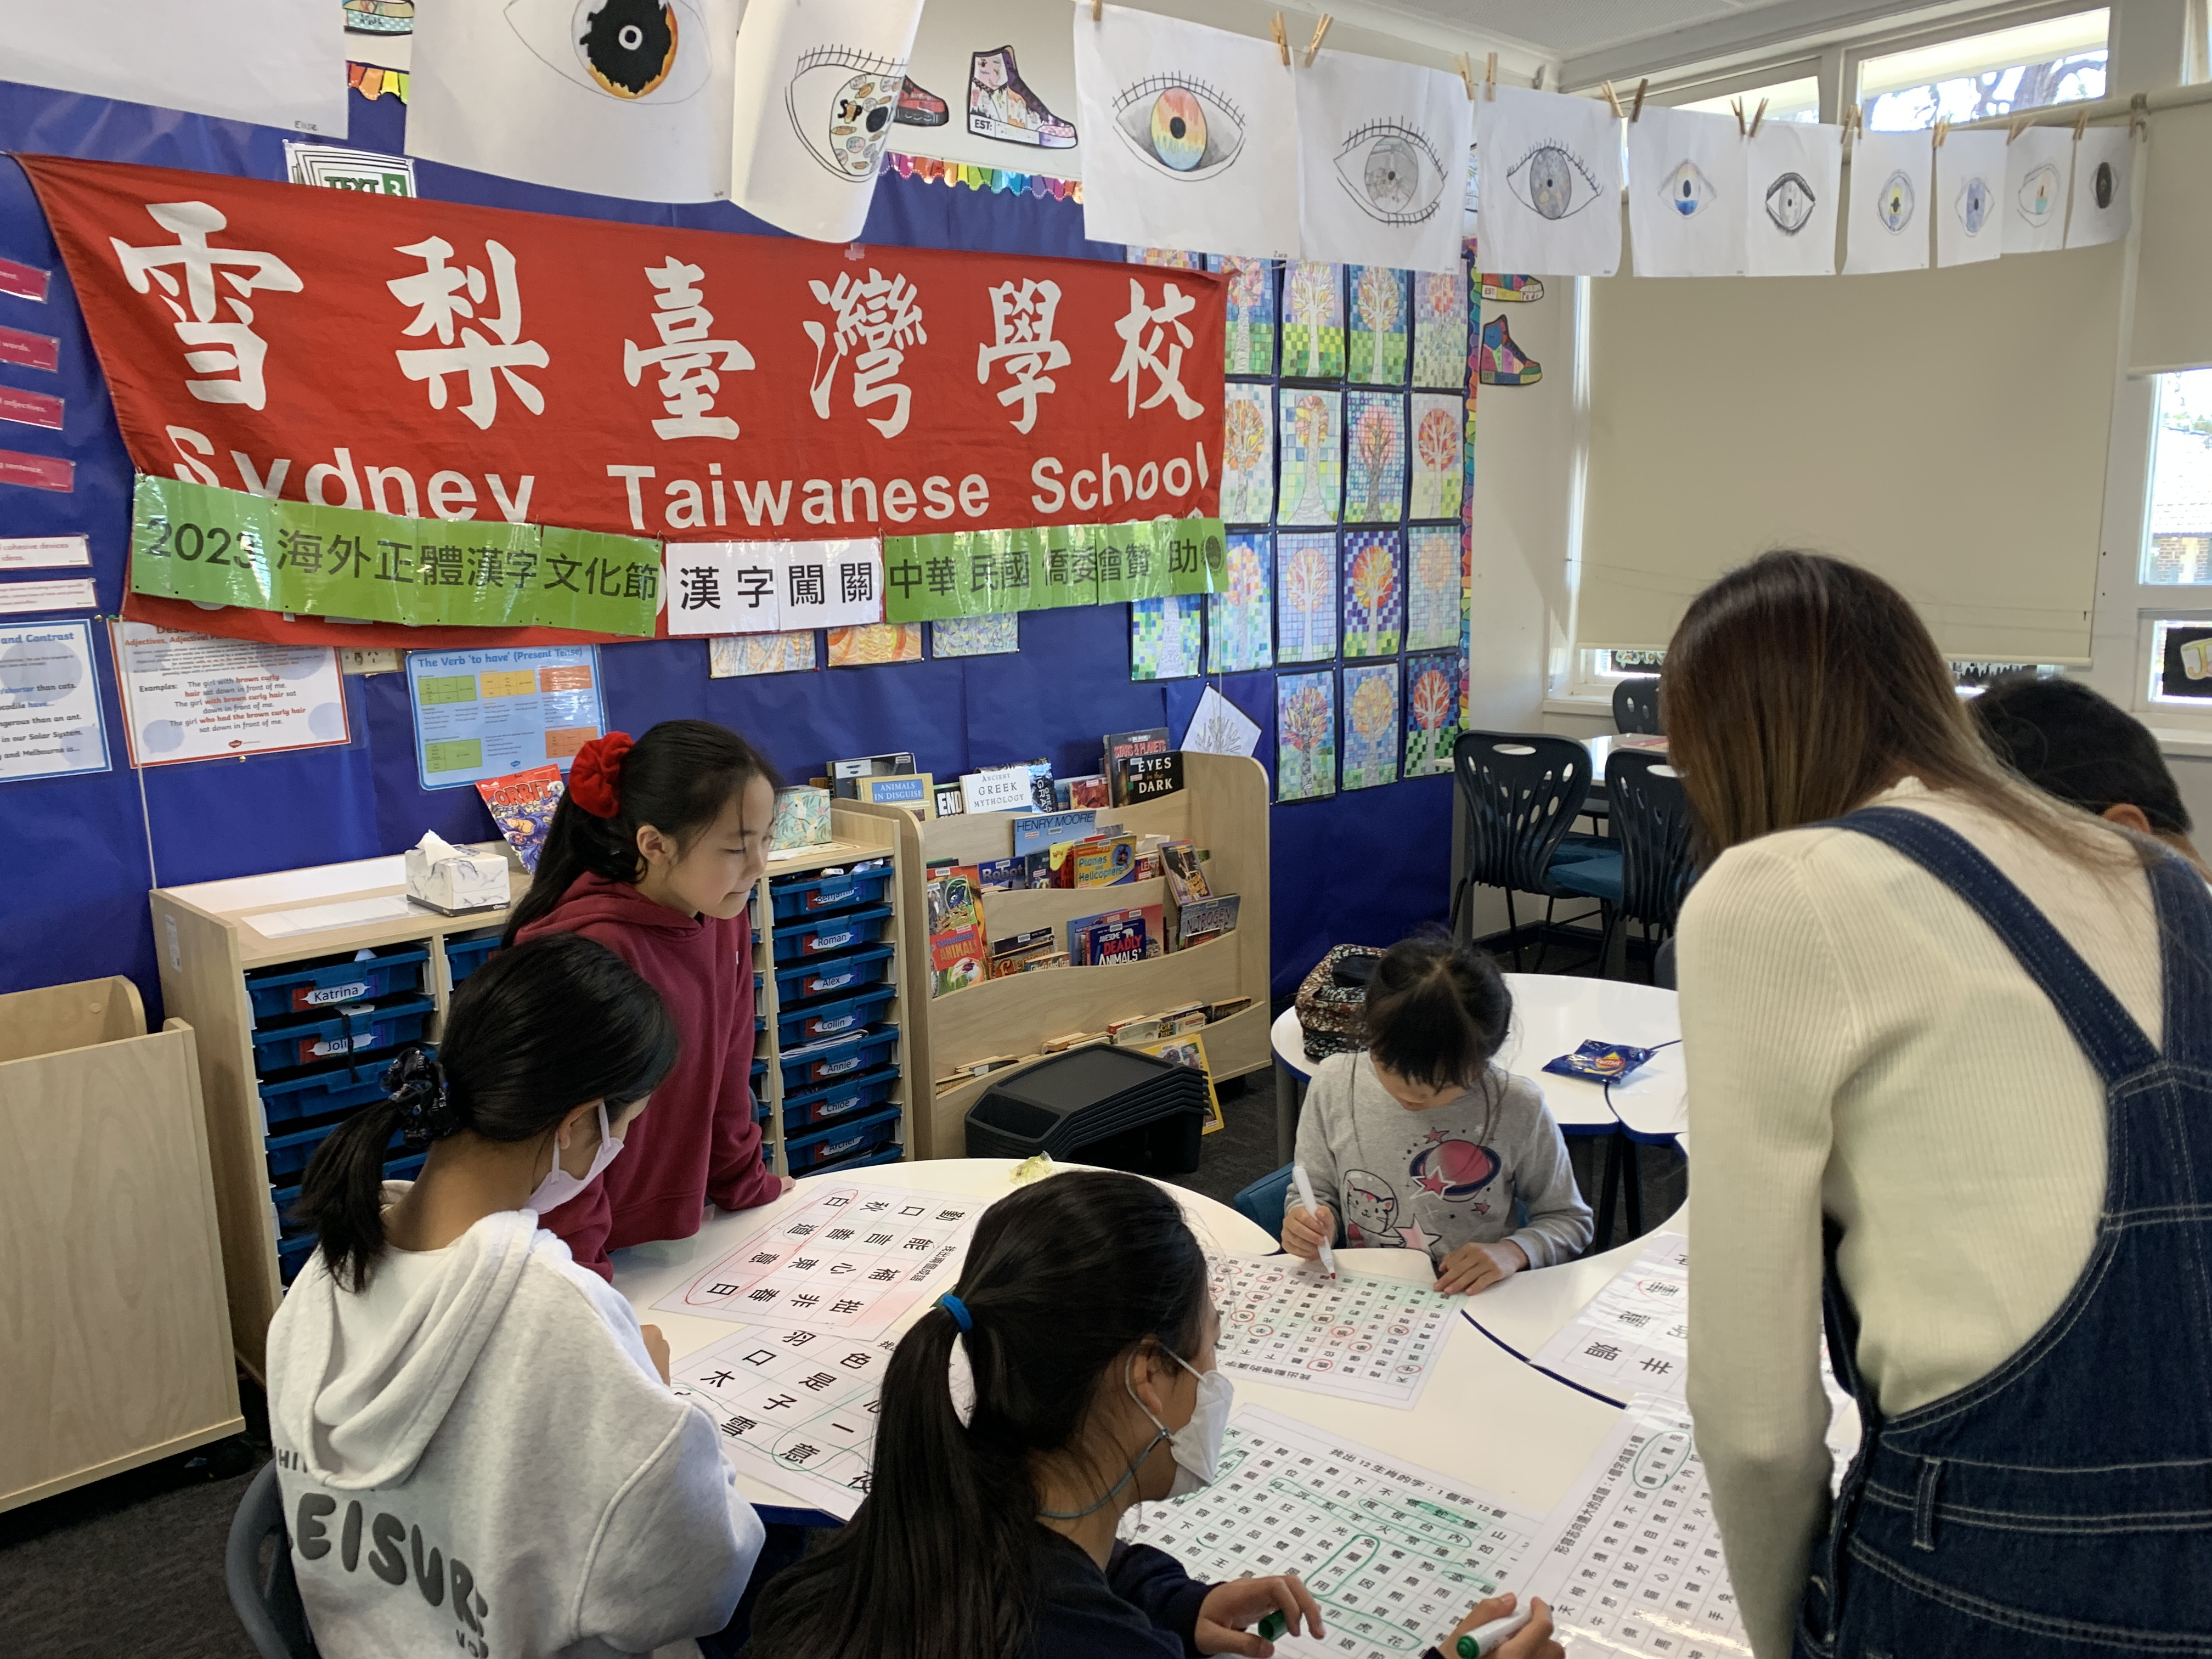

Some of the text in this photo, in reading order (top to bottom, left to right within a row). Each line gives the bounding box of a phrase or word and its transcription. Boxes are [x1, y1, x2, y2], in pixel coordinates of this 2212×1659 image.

[110, 201, 1204, 441] 雪梨臺灣學校
[166, 425, 1209, 529] Sydney Taiwanese School
[277, 528, 658, 601] 海外正體漢字文化節
[680, 562, 873, 610] 漢字闖關
[1, 632, 74, 644] and Contrast
[417, 658, 438, 668] The
[441, 656, 465, 666] Verb
[139, 684, 178, 692] Examples:
[23, 748, 65, 756] Melbourne
[1138, 757, 1172, 772] EYES
[494, 780, 551, 807] ORBIT
[881, 782, 915, 792] ANIMALS
[979, 782, 1018, 795] GREEK
[1139, 778, 1173, 794] DARK
[886, 790, 923, 799] DISGUISE
[974, 794, 1024, 808] MYTHOLOGY
[937, 791, 963, 816] END
[1017, 812, 1096, 832] HENRY MOORE
[1187, 907, 1230, 932] NITROGEN
[818, 933, 847, 947] Roman
[1099, 932, 1120, 943] AWESOME
[1104, 934, 1142, 956] DEADLY
[822, 977, 840, 988] Alex
[314, 986, 359, 1002] Katrina
[821, 1019, 845, 1030] Collin
[827, 1061, 851, 1073] Annie
[827, 1099, 850, 1113] Chloe
[859, 1201, 889, 1213] 秋
[707, 1195, 849, 1296] 白 道 意 日
[791, 1205, 926, 1308] 口 言 心 非
[829, 1209, 966, 1314] 勤 能 補 拙
[747, 1288, 780, 1302] 春
[782, 1329, 872, 1370] 羽 色
[742, 1348, 777, 1366] 口
[799, 1372, 837, 1392] 是
[763, 1393, 798, 1411] 子
[779, 1442, 821, 1464] 意
